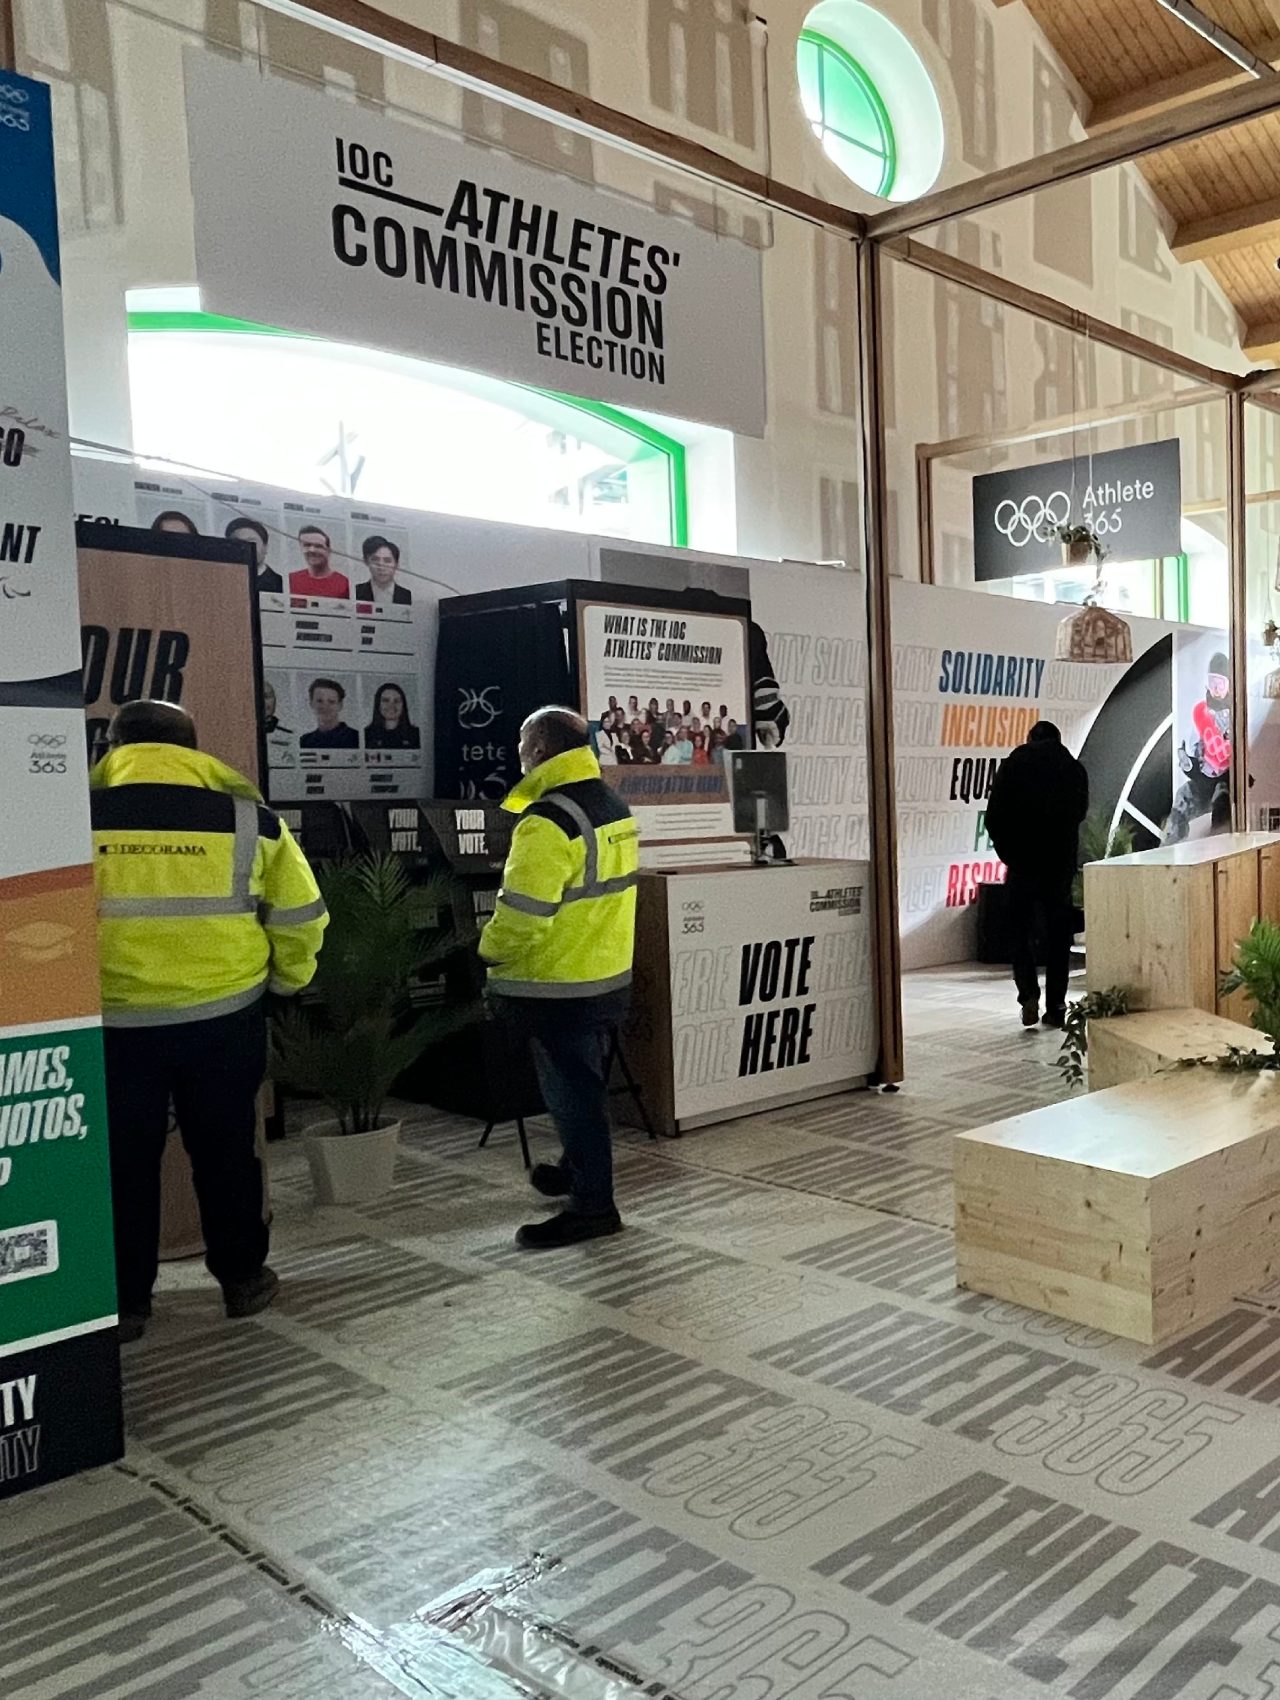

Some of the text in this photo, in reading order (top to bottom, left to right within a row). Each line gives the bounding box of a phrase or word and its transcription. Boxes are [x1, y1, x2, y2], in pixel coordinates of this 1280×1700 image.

[336, 138, 394, 187] IOC
[444, 180, 680, 295] ATHLETES'
[331, 204, 665, 350] COMMISSION
[536, 323, 665, 384] ELECTION
[1082, 479, 1154, 508] Athlete
[1083, 507, 1123, 535] 365
[604, 614, 687, 640] WHAT IS THE IOC
[657, 642, 723, 665] COMMISSION
[939, 650, 1046, 698] SOLIDARITY
[29, 760, 67, 774] 365
[455, 809, 485, 830] YOUR
[738, 936, 815, 1006] VOTE
[738, 1003, 816, 1077] HERE
[747, 1301, 1245, 1496] ATHLETE 365
